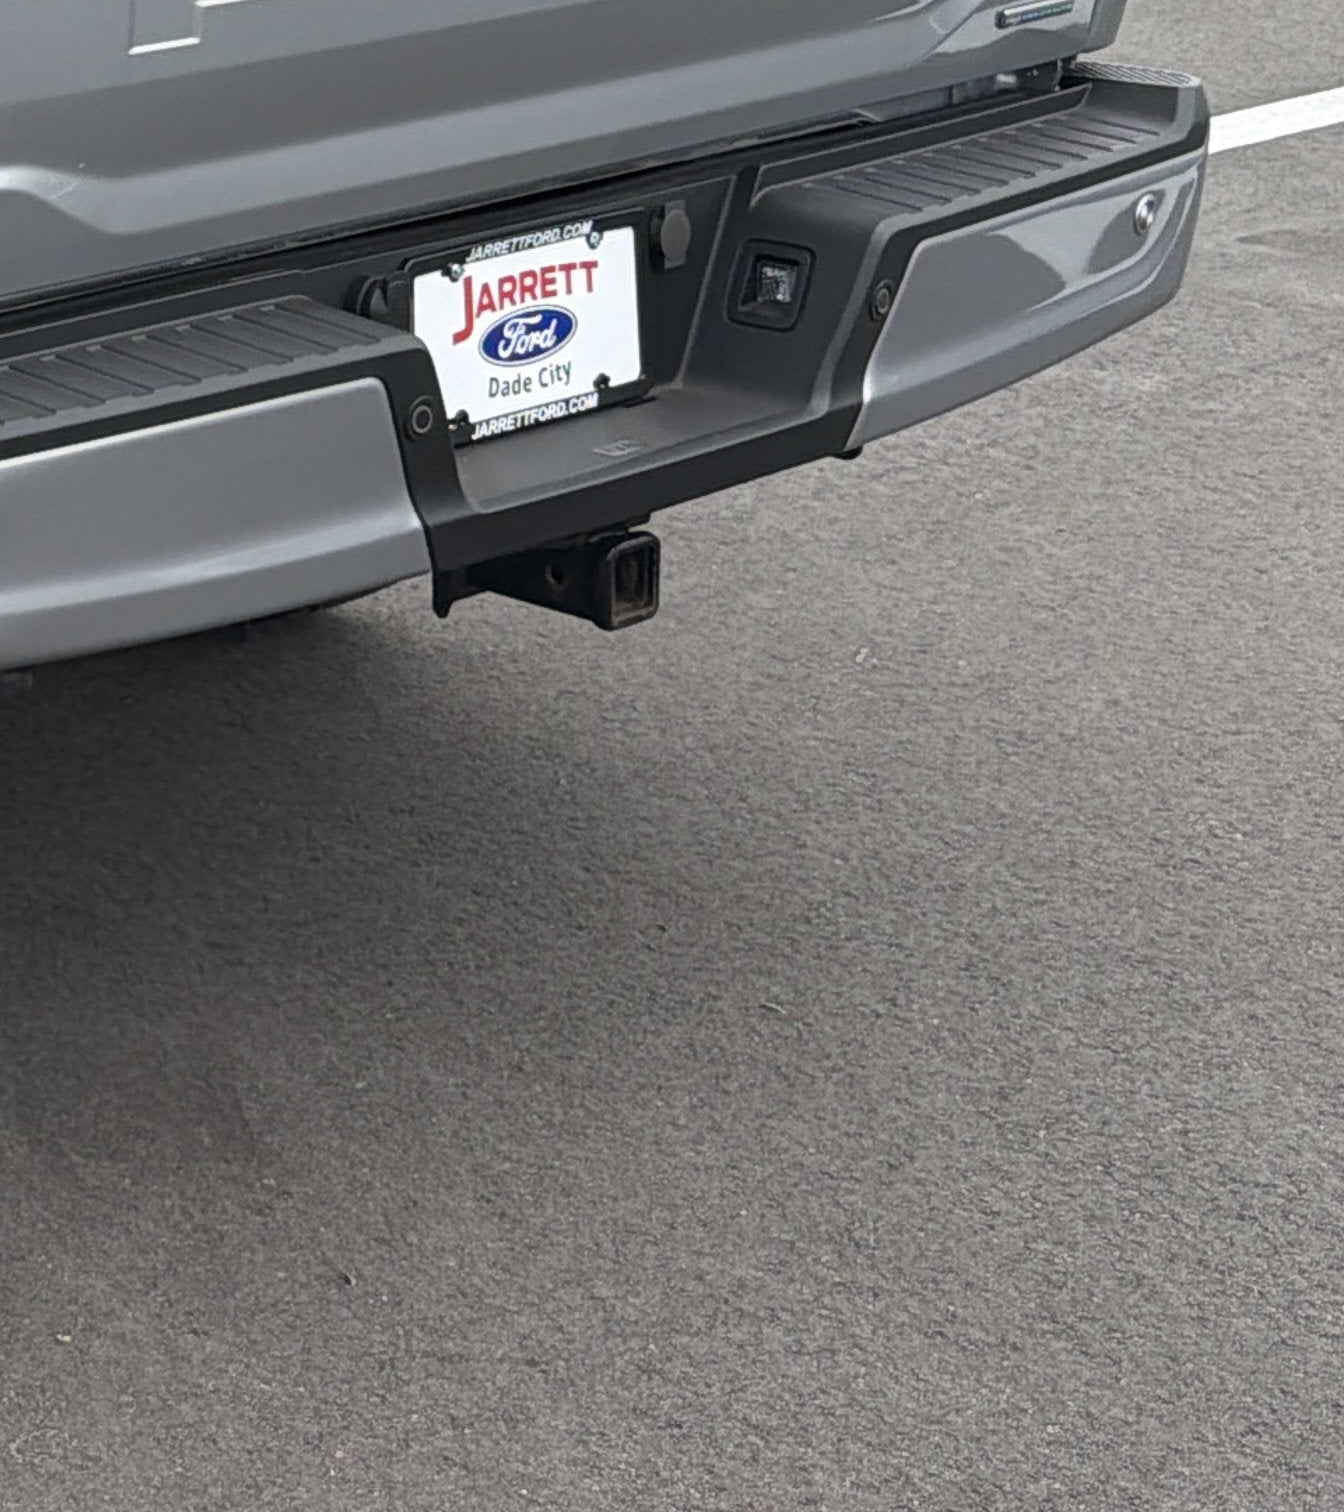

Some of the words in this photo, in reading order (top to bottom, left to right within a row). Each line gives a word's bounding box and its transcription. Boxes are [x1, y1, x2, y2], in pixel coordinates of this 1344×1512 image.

[465, 219, 595, 263] JARRETTFORD.COM
[452, 260, 599, 346] JARRETT
[497, 314, 558, 359] Ford
[487, 372, 533, 399] Dade
[538, 361, 573, 387] City
[471, 392, 600, 440] JARRETTFORD.COM
